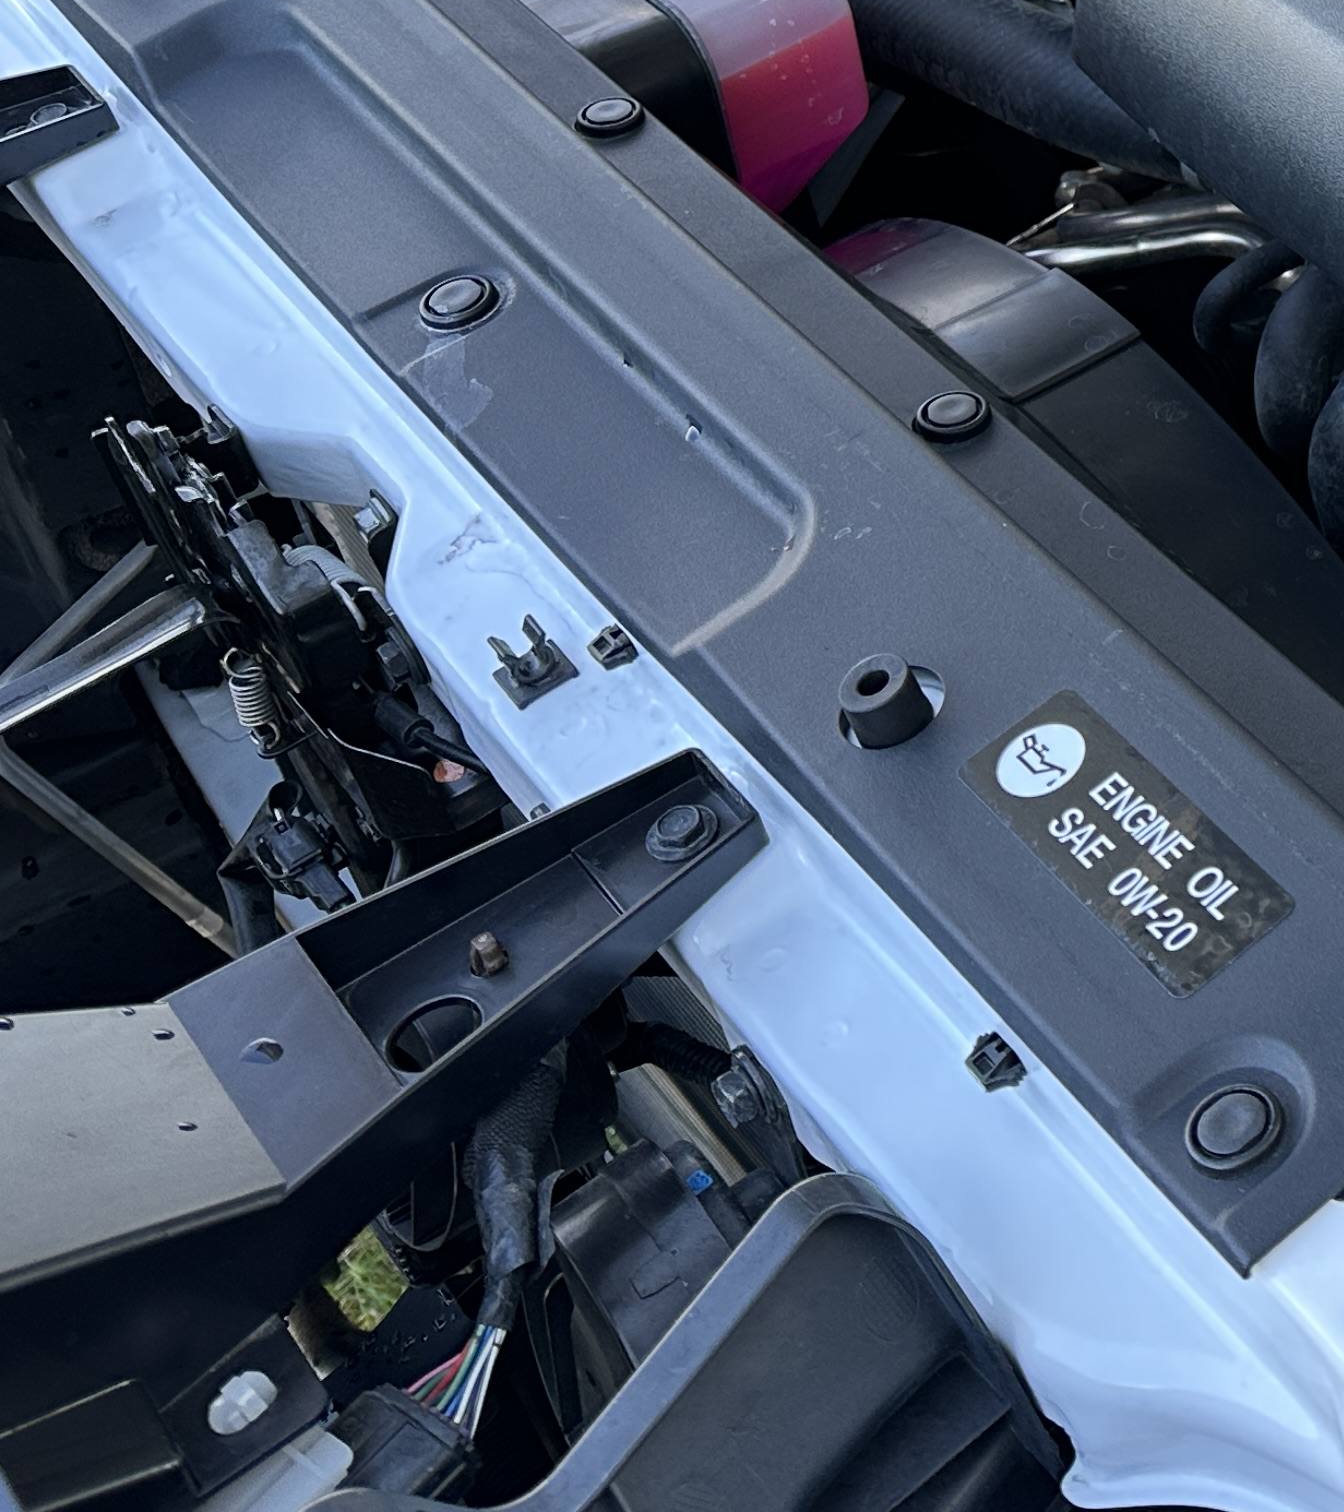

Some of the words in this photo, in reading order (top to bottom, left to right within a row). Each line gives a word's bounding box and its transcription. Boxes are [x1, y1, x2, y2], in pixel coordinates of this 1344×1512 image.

[1048, 807, 1116, 870] SAE
[1108, 868, 1198, 952] 0W-20
[1088, 772, 1195, 870] ENGINE
[1187, 867, 1240, 920] OIL
